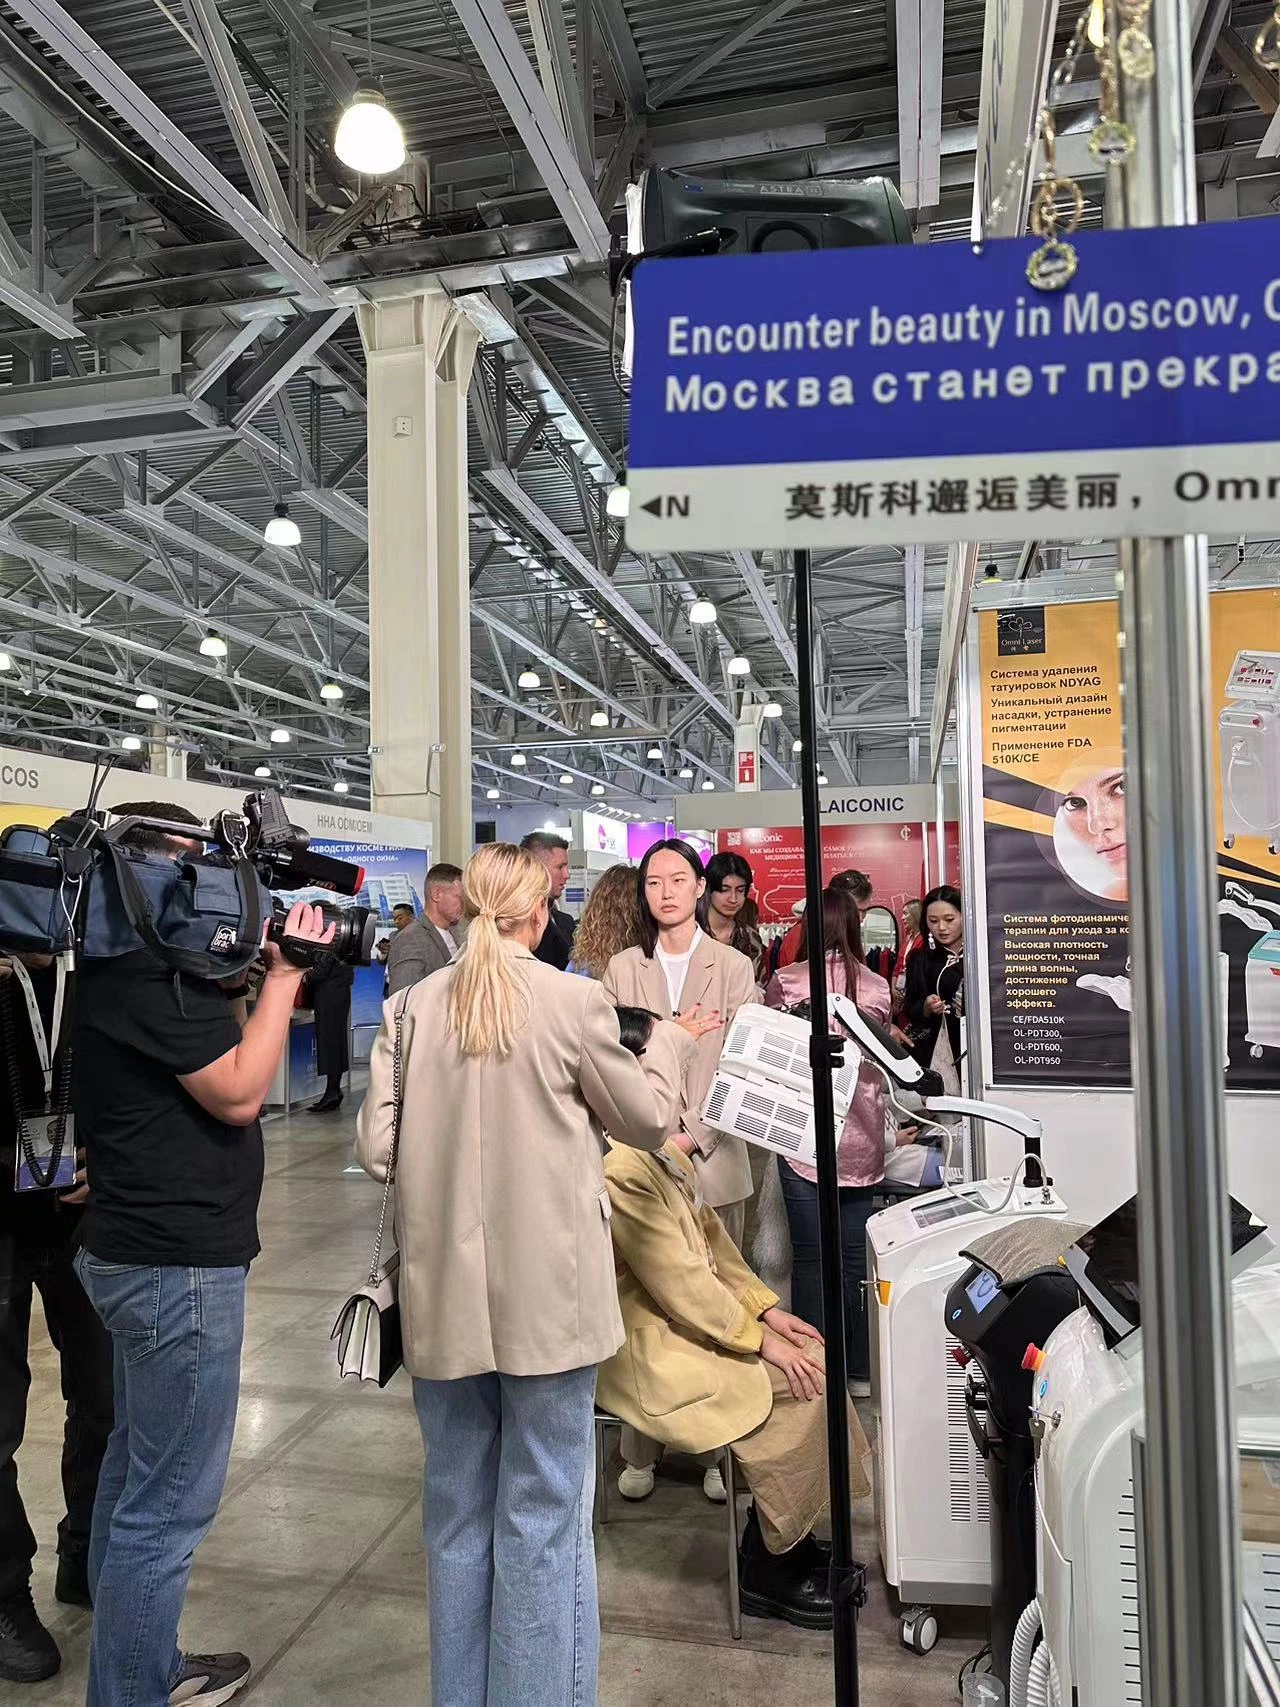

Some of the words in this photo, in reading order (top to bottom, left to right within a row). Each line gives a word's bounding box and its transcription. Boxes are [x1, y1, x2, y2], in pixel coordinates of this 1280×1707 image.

[668, 313, 861, 356] Encounter
[870, 305, 1004, 349] beauty
[1016, 297, 1050, 338] in
[1063, 292, 1252, 335] Moscow,
[665, 374, 854, 413] Москва
[872, 363, 1066, 403] станет
[667, 495, 690, 518] N
[991, 669, 1039, 679] Система
[1042, 665, 1098, 678] удаления
[991, 681, 1057, 693] татуировок
[1059, 676, 1101, 688] NDYAG
[991, 695, 1062, 707] Уникальный
[1065, 693, 1108, 705] дизайн
[991, 711, 1041, 720] насадки,
[1044, 707, 1112, 719] устранение
[991, 723, 1066, 733] пигментации
[992, 740, 1064, 751] Применение
[1067, 738, 1092, 748] FDA
[992, 753, 1040, 764] 510K/CE
[1, 765, 39, 789] COS
[307, 844, 357, 854] ИЗВОДСТВУ
[1003, 914, 1047, 923] Система
[1004, 927, 1047, 936] терапии
[1049, 927, 1069, 935] для
[1071, 926, 1103, 936] ухода
[1105, 926, 1117, 934] за
[1004, 940, 1050, 949] Высокая
[1053, 941, 1108, 949] плотность
[1005, 953, 1061, 961] мощности,
[1005, 965, 1037, 973] длина
[1040, 965, 1078, 974] волны,
[1005, 976, 1068, 985] достижение
[1006, 988, 1056, 997] хорошего
[1007, 999, 1056, 1009] эффекта.
[1013, 1015, 1065, 1024] CE/FDA510K
[1013, 1029, 1062, 1039] OL-PDT300,
[1013, 1042, 1063, 1052] OL-PDT600,
[1014, 1056, 1061, 1065] OL-PDT950
